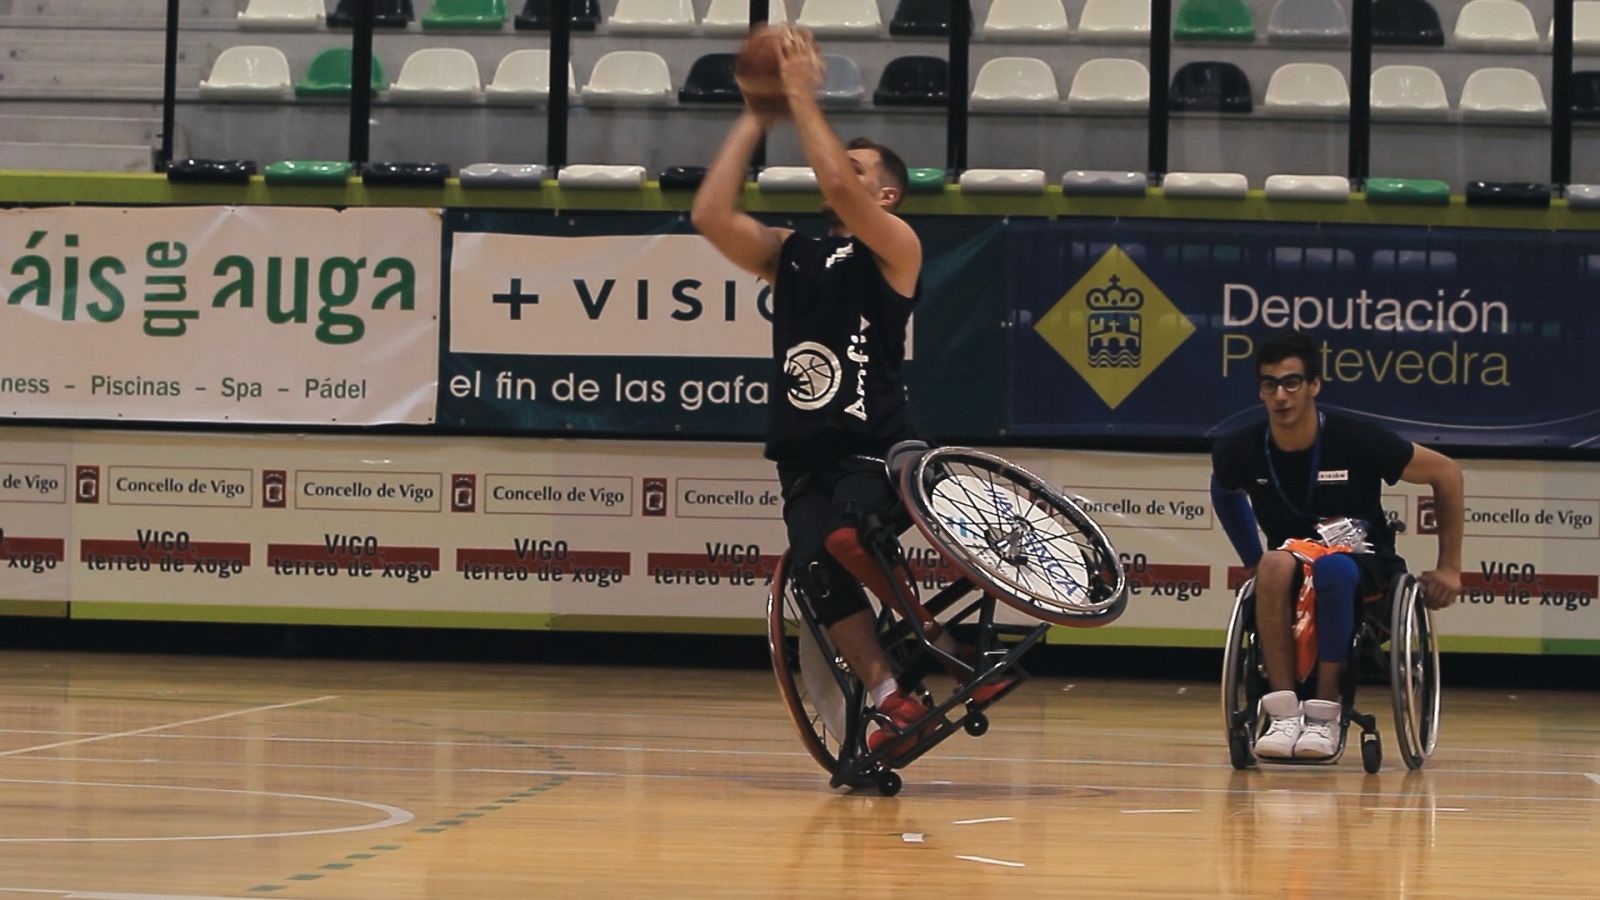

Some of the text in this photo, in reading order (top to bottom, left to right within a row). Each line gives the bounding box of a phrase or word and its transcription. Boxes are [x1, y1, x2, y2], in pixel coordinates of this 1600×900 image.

[143, 240, 199, 337] que
[212, 253, 416, 345] auga
[573, 276, 774, 322] VISI
[1222, 283, 1509, 334] Deputación
[1222, 335, 1511, 387] Ptevedra
[0, 377, 49, 394] ness
[91, 375, 181, 396] Piscinas
[221, 377, 262, 400] Spa
[305, 377, 366, 399] Pádel
[450, 371, 769, 410] el fin de las gafa
[3, 474, 58, 494] de Vigo
[116, 477, 245, 497] Concello de Vigo
[303, 482, 433, 502] Concello de Vigo
[493, 485, 624, 506] Concello de Vigo
[684, 490, 778, 506] Concello de
[1146, 500, 1165, 515] de
[1169, 502, 1204, 520] Vigo
[1535, 510, 1554, 525] de
[1558, 510, 1593, 529] Vigo
[8, 554, 57, 574] xogo
[87, 551, 243, 578] terreo de xogo
[274, 557, 432, 583] terreo de xogo
[463, 560, 623, 587] terreo de xogo
[655, 566, 720, 585] terreo
[729, 568, 755, 586] de
[1151, 580, 1203, 601] xogo
[1504, 587, 1530, 605] de
[1540, 590, 1591, 611] xogo
